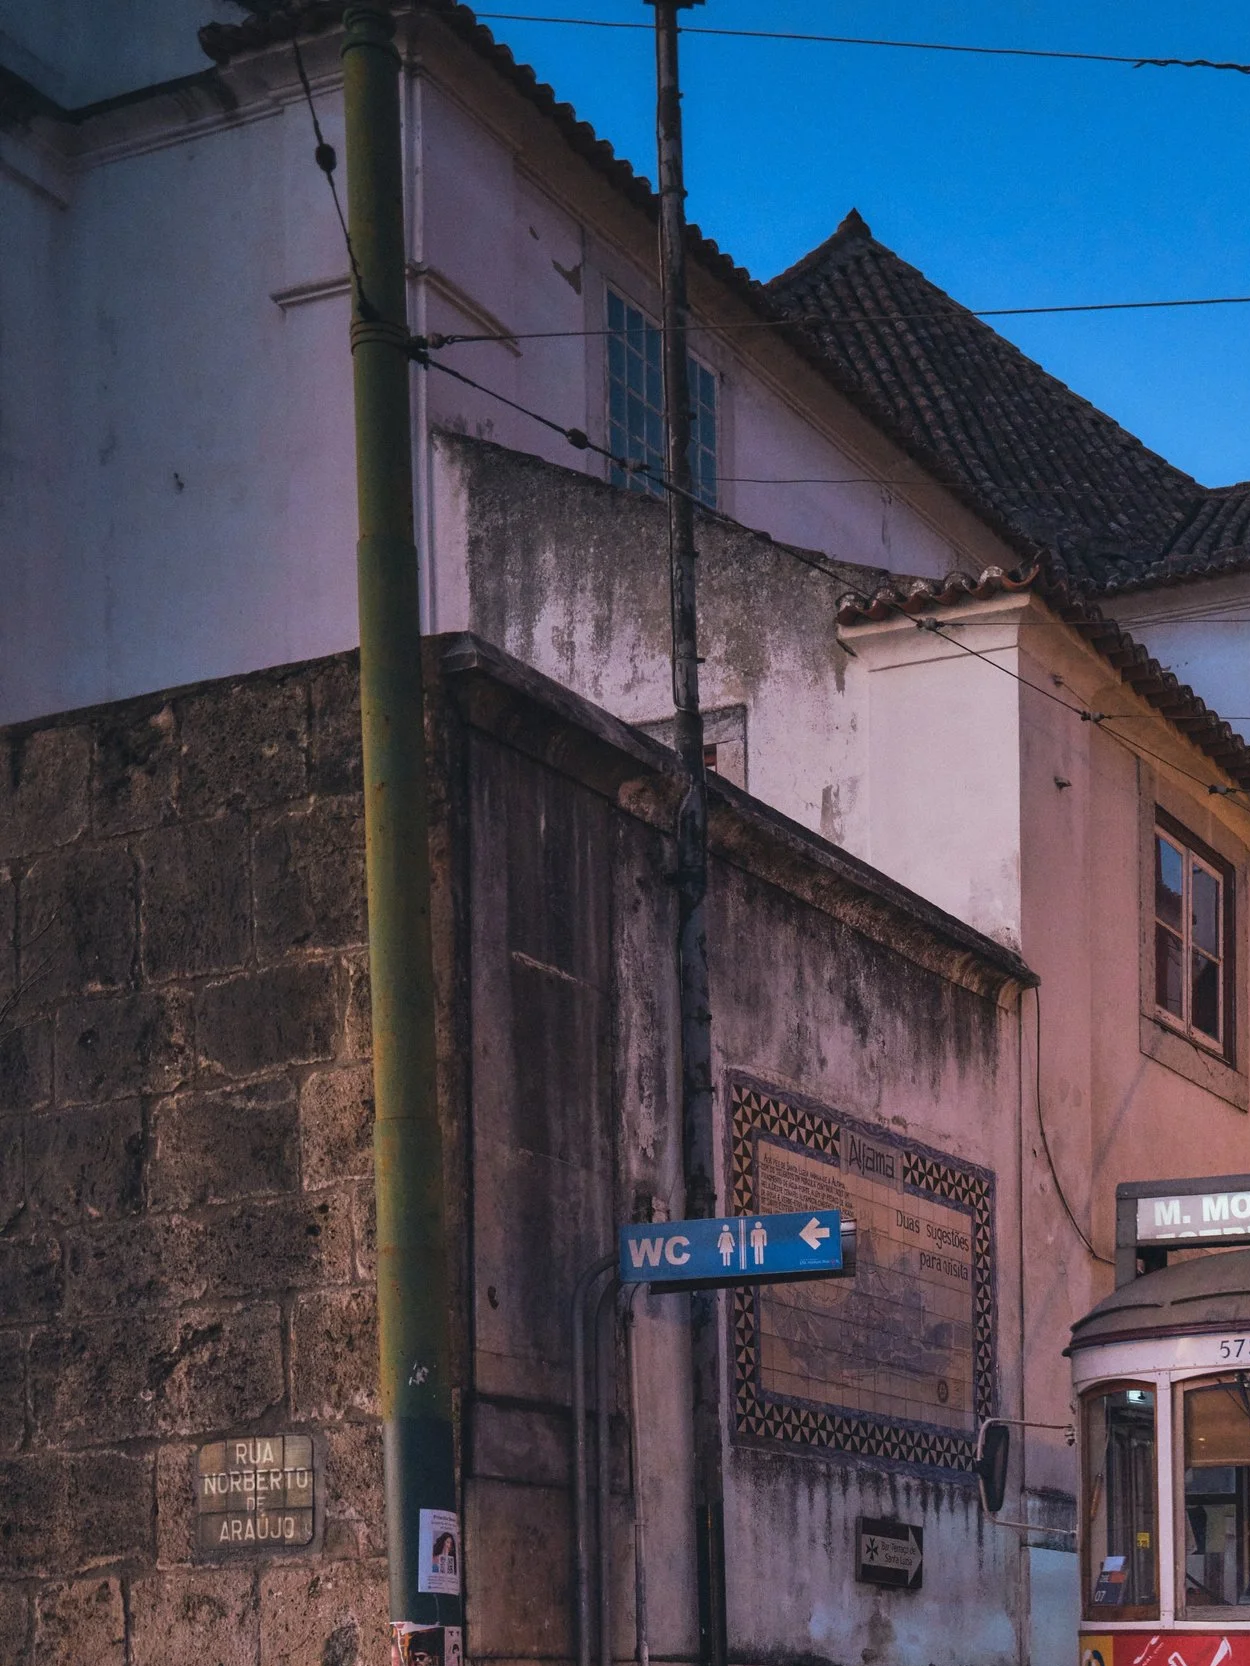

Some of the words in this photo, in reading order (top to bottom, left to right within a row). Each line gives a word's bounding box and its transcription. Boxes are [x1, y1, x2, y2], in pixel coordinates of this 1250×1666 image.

[849, 1135, 895, 1178] Alfama
[1154, 1199, 1191, 1227] M.
[896, 1210, 920, 1234] Duas
[926, 1224, 969, 1252] sugestões
[628, 1235, 691, 1268] WC
[920, 1252, 942, 1272] para
[235, 1442, 274, 1464] RUA
[204, 1467, 308, 1495] NORBERTO
[247, 1497, 266, 1511] DE
[220, 1513, 295, 1542] ARAÚJO
